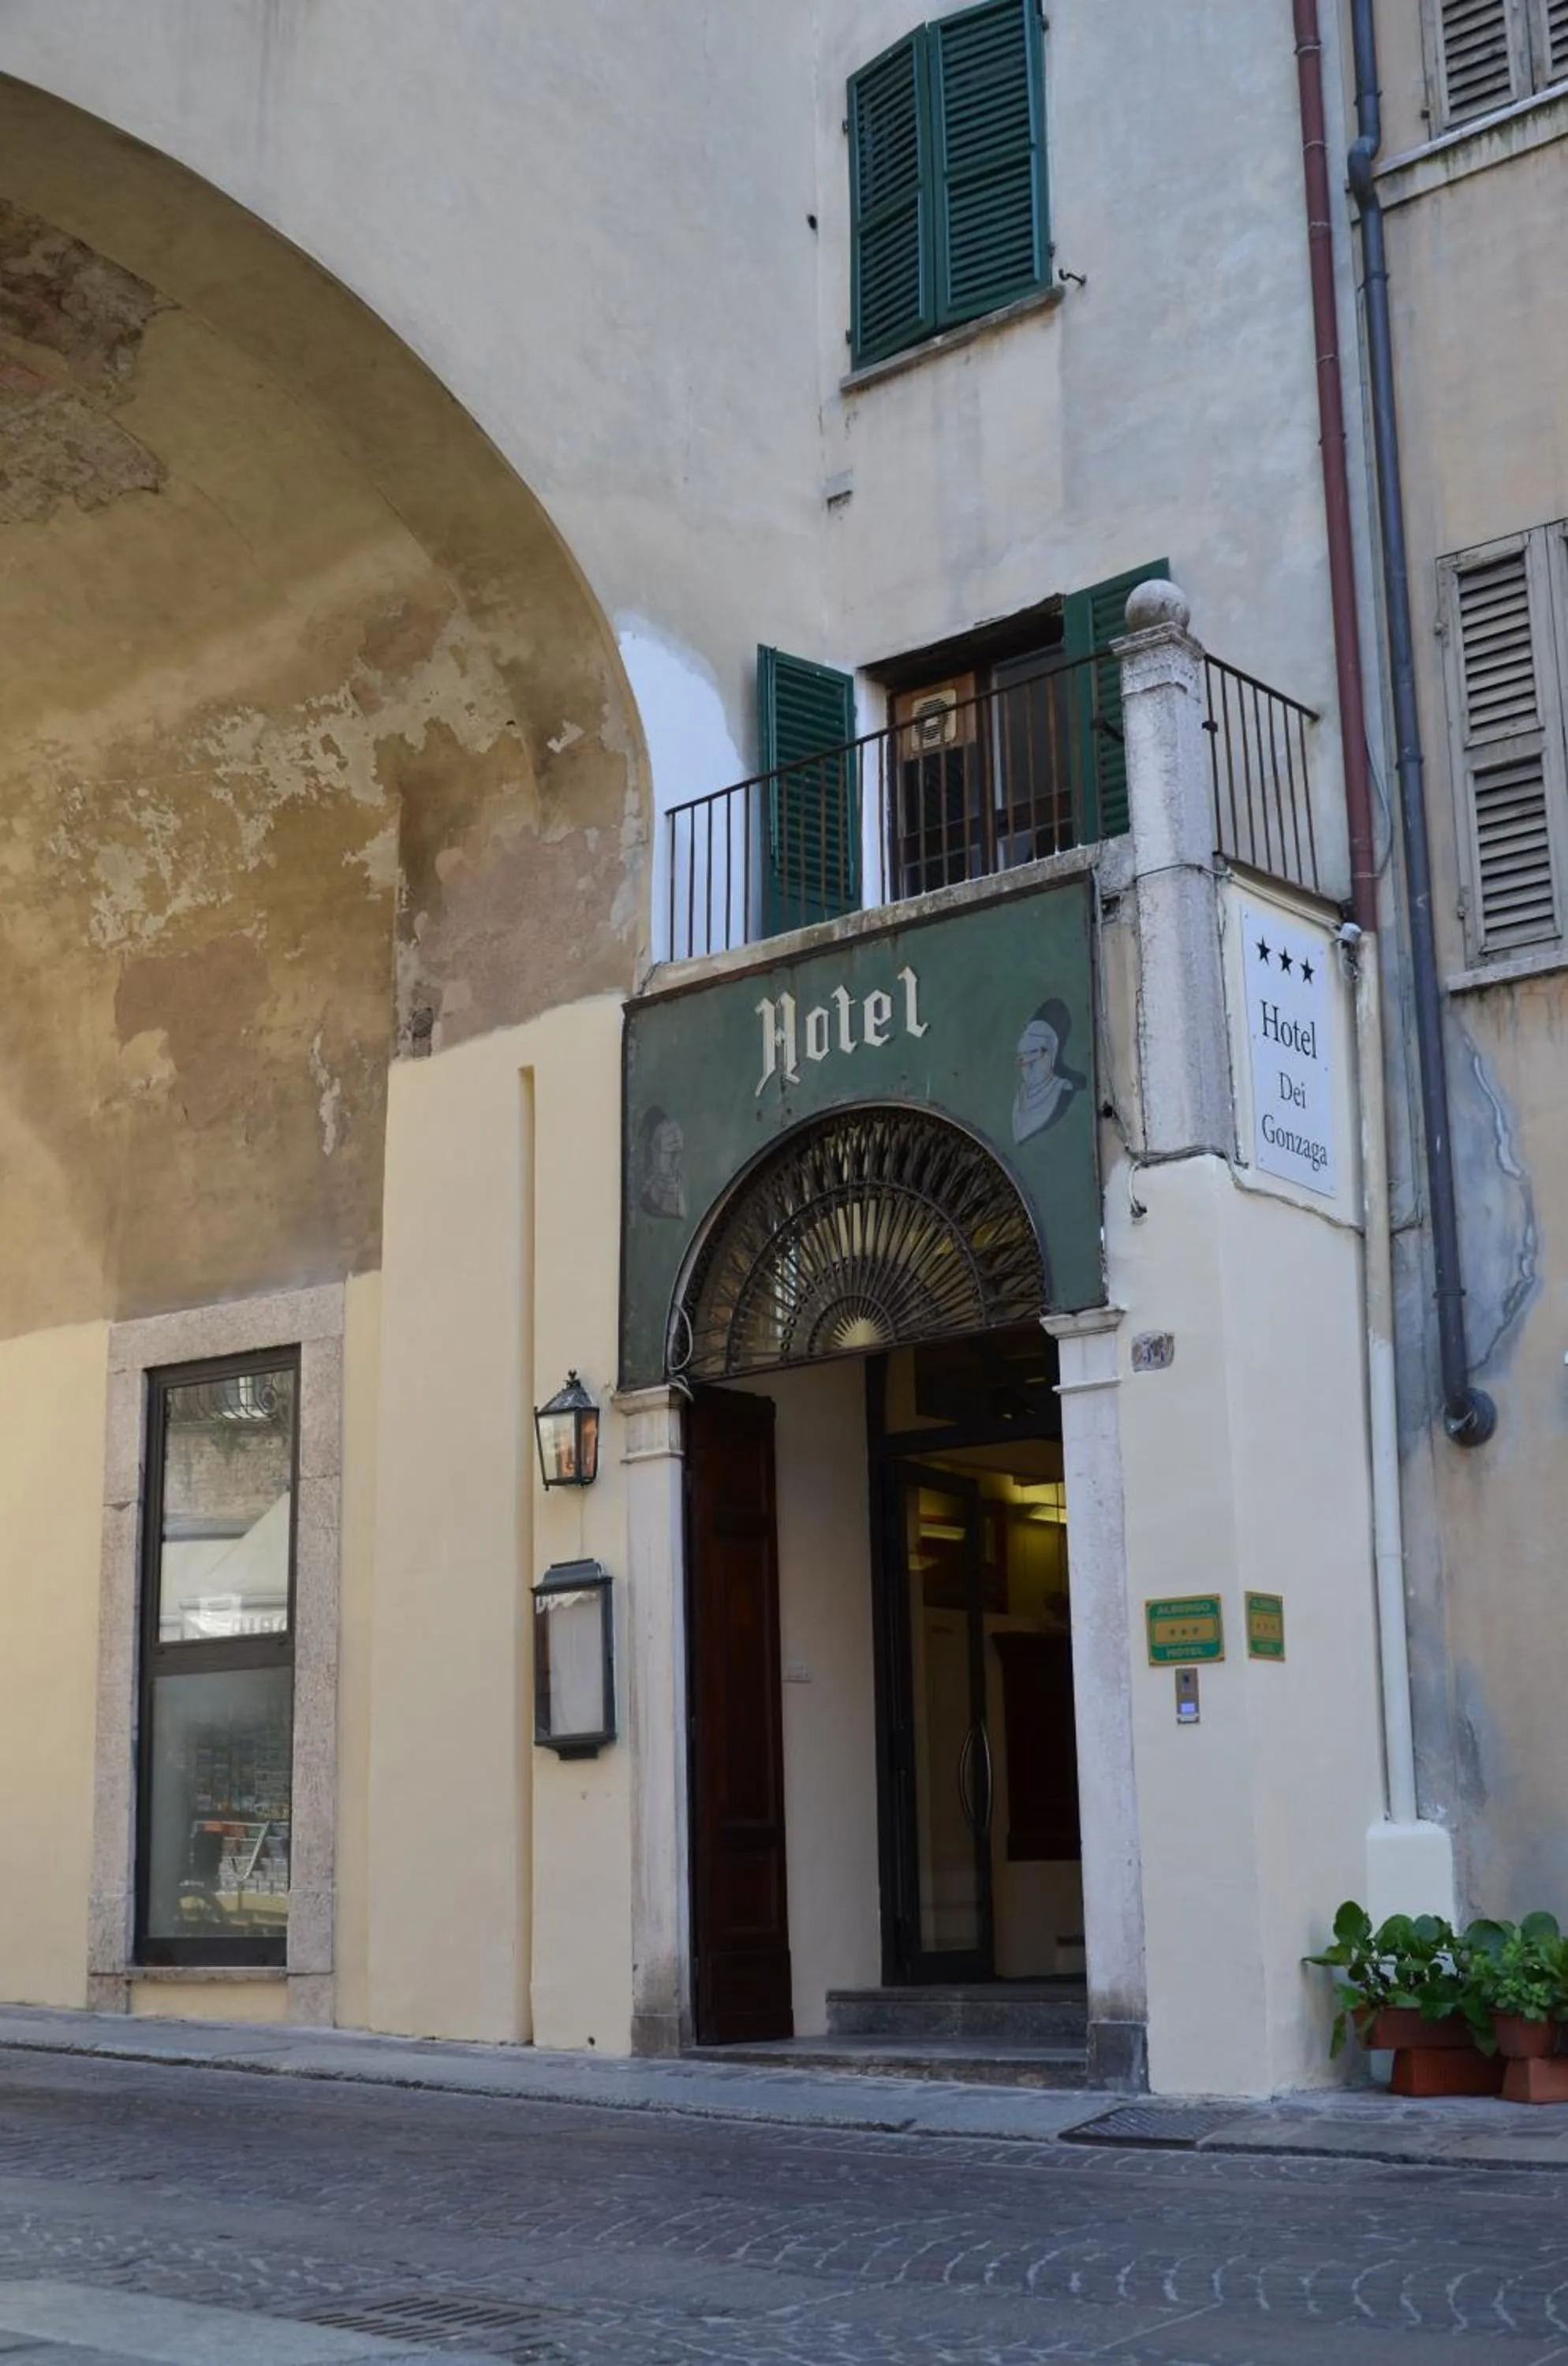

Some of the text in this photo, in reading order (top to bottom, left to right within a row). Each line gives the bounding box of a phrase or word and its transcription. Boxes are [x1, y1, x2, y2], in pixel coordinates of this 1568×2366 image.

[755, 965, 928, 1098] Hotel
[1260, 999, 1317, 1059] Hotel
[1279, 1071, 1306, 1109] Dei
[1261, 1114, 1328, 1171] Gonzaga
[1166, 1645, 1205, 1659] HOTEL
